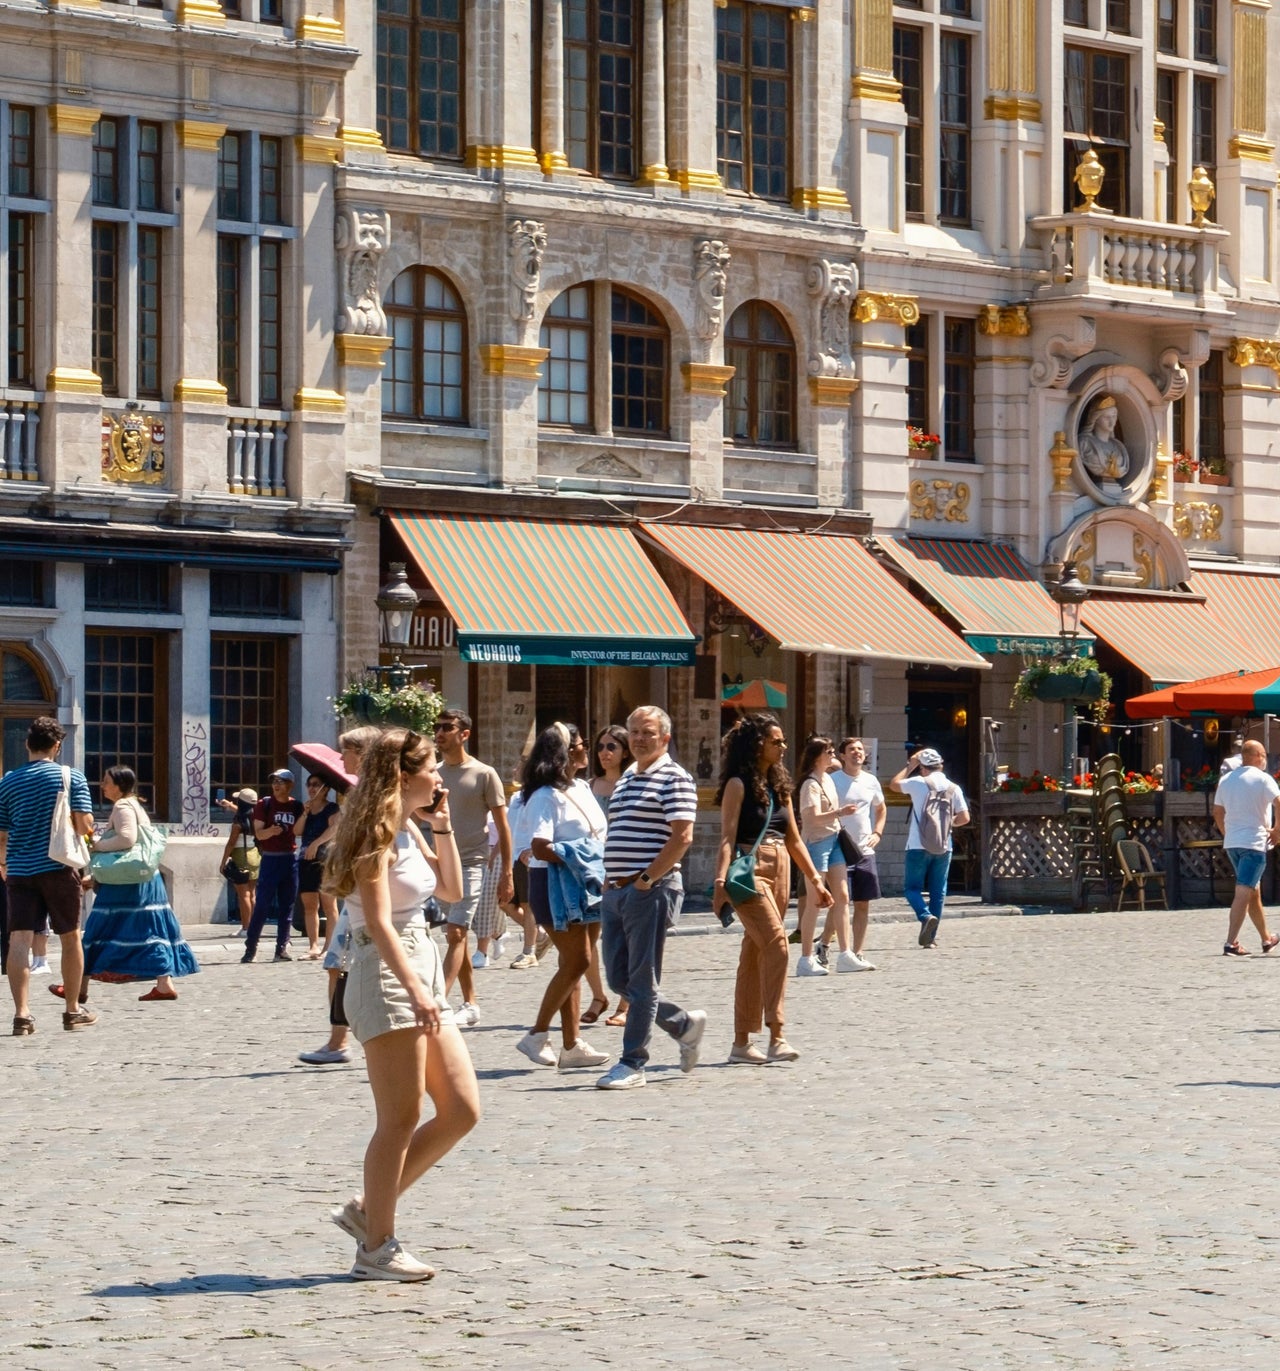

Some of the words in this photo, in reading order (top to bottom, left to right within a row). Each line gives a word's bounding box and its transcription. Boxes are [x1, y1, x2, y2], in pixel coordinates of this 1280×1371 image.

[468, 643, 522, 663] NEUHAUS
[571, 650, 606, 660] INVENTOR
[606, 651, 615, 660] OF
[615, 651, 630, 661] THE
[631, 651, 660, 661] BELGIAN
[661, 652, 689, 662] PRALINE
[514, 703, 525, 715] 27
